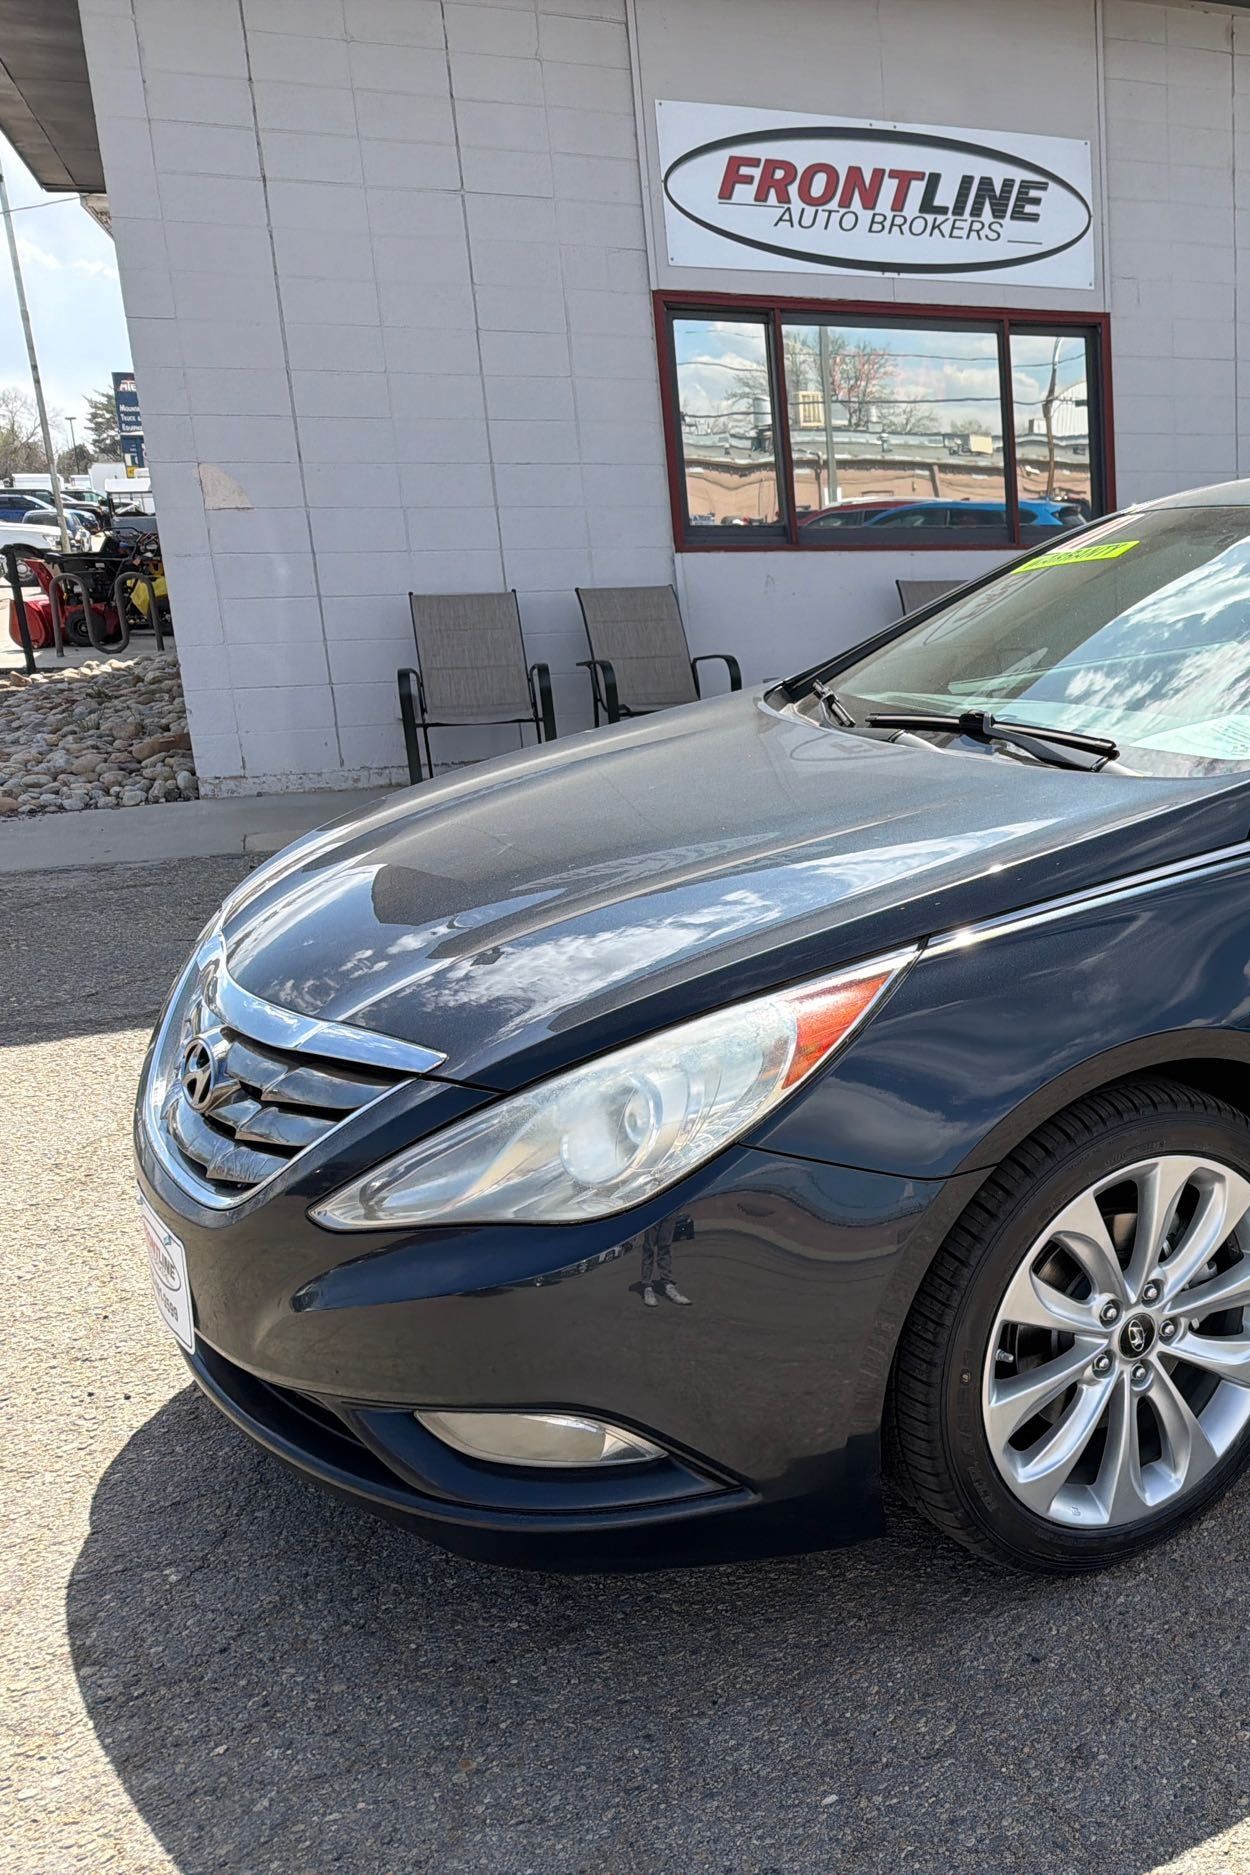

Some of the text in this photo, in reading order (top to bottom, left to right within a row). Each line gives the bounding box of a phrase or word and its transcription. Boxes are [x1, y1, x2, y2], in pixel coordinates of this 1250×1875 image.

[717, 155, 1049, 223] FRONTLINE
[773, 206, 1004, 242] AUTO BROKERS
